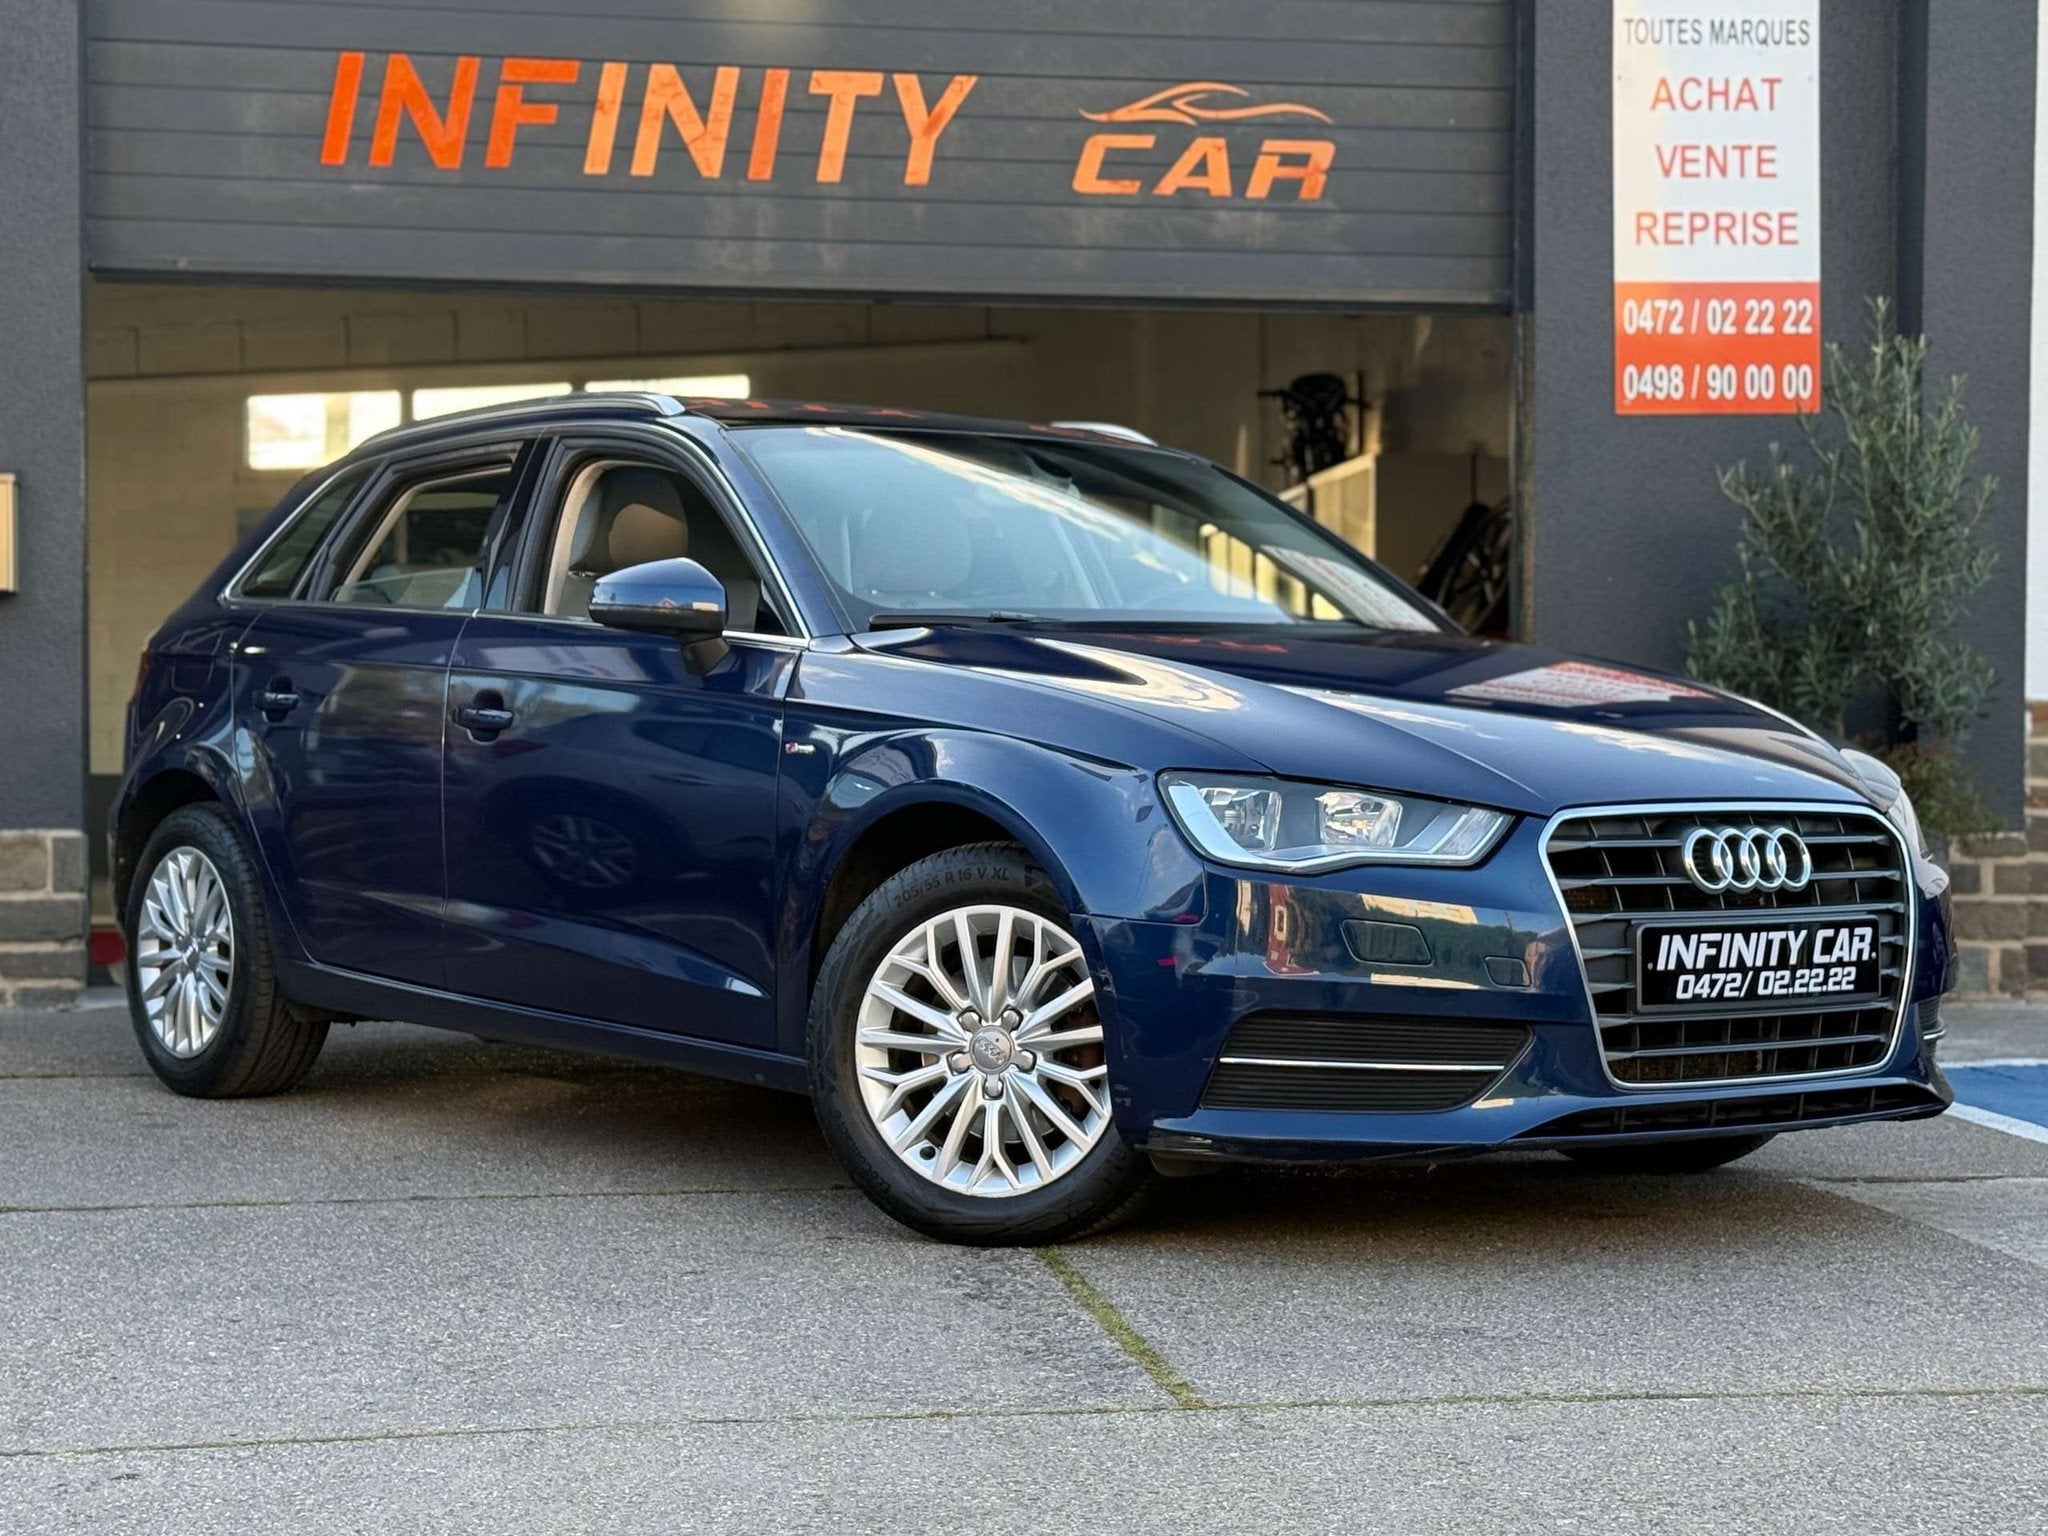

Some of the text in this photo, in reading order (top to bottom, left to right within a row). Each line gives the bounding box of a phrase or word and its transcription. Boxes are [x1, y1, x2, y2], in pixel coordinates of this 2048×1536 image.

[1624, 18, 1811, 46] TOUTES MARQUES
[1650, 77, 1783, 112] ACHAT
[320, 50, 1337, 201] INFINITY CAR
[1655, 145, 1778, 179] VENTE
[1635, 211, 1799, 246] REPRISE
[1623, 298, 1684, 336] 0472
[1706, 298, 1737, 335] 02
[1744, 298, 1775, 335] 22
[1782, 298, 1813, 335] 22
[1623, 363, 1684, 401] 0498
[1706, 363, 1737, 400] 90
[1744, 363, 1775, 400] 00
[1782, 363, 1813, 400] 00
[1656, 927, 1874, 972] INFINITY CAR
[1676, 966, 1857, 1000] 0472/ 02.22.22
